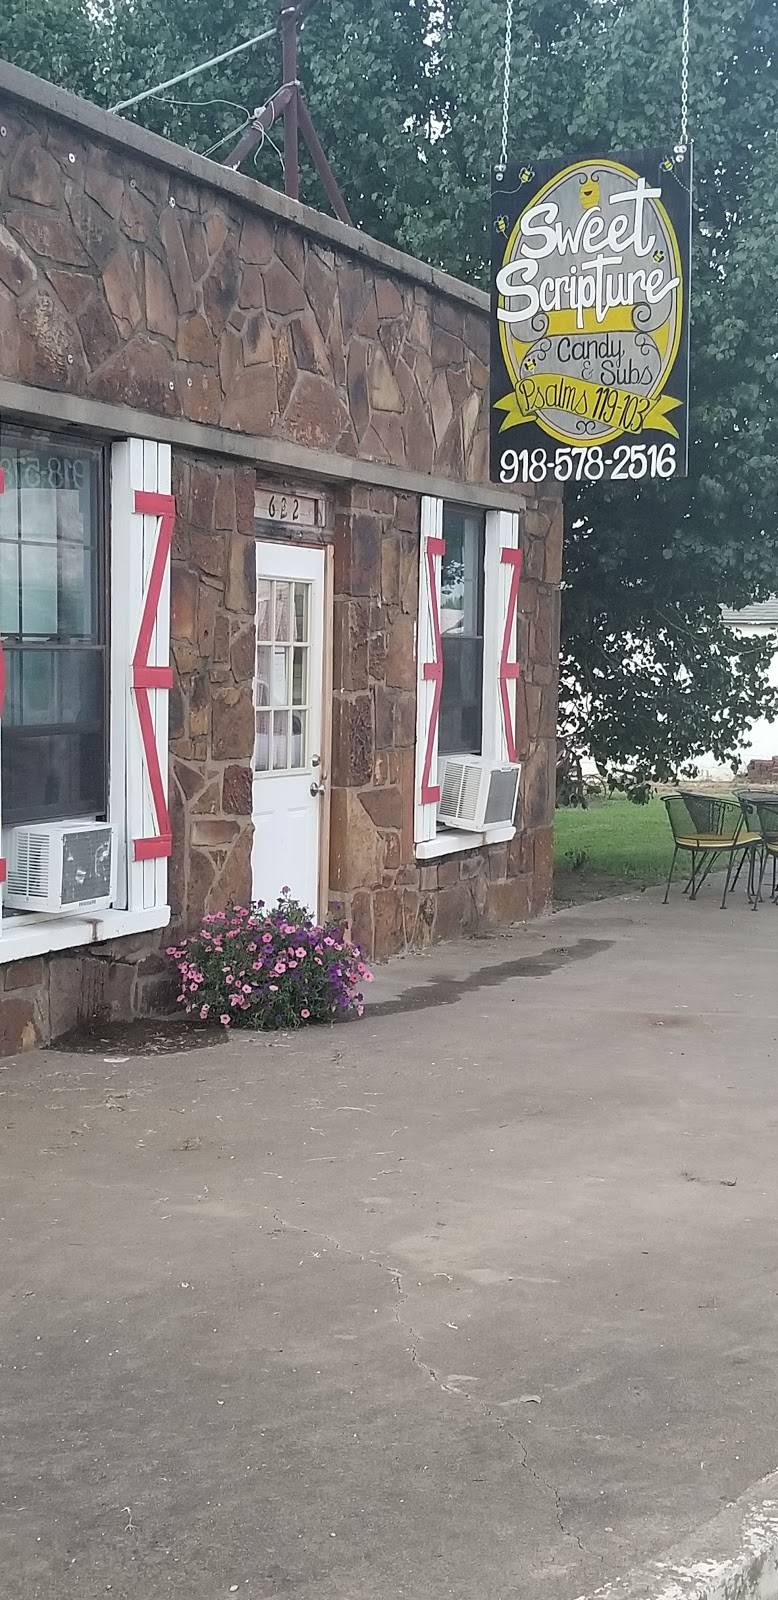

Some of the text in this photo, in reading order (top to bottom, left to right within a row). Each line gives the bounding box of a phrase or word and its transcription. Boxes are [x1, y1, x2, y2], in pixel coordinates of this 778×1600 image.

[520, 177, 662, 259] Sweet
[496, 254, 680, 329] Scripture
[557, 334, 625, 367] Candy
[581, 358, 653, 385] & Subs
[520, 378, 650, 432] Psalms 119-103
[500, 443, 676, 482] 918-578-2516
